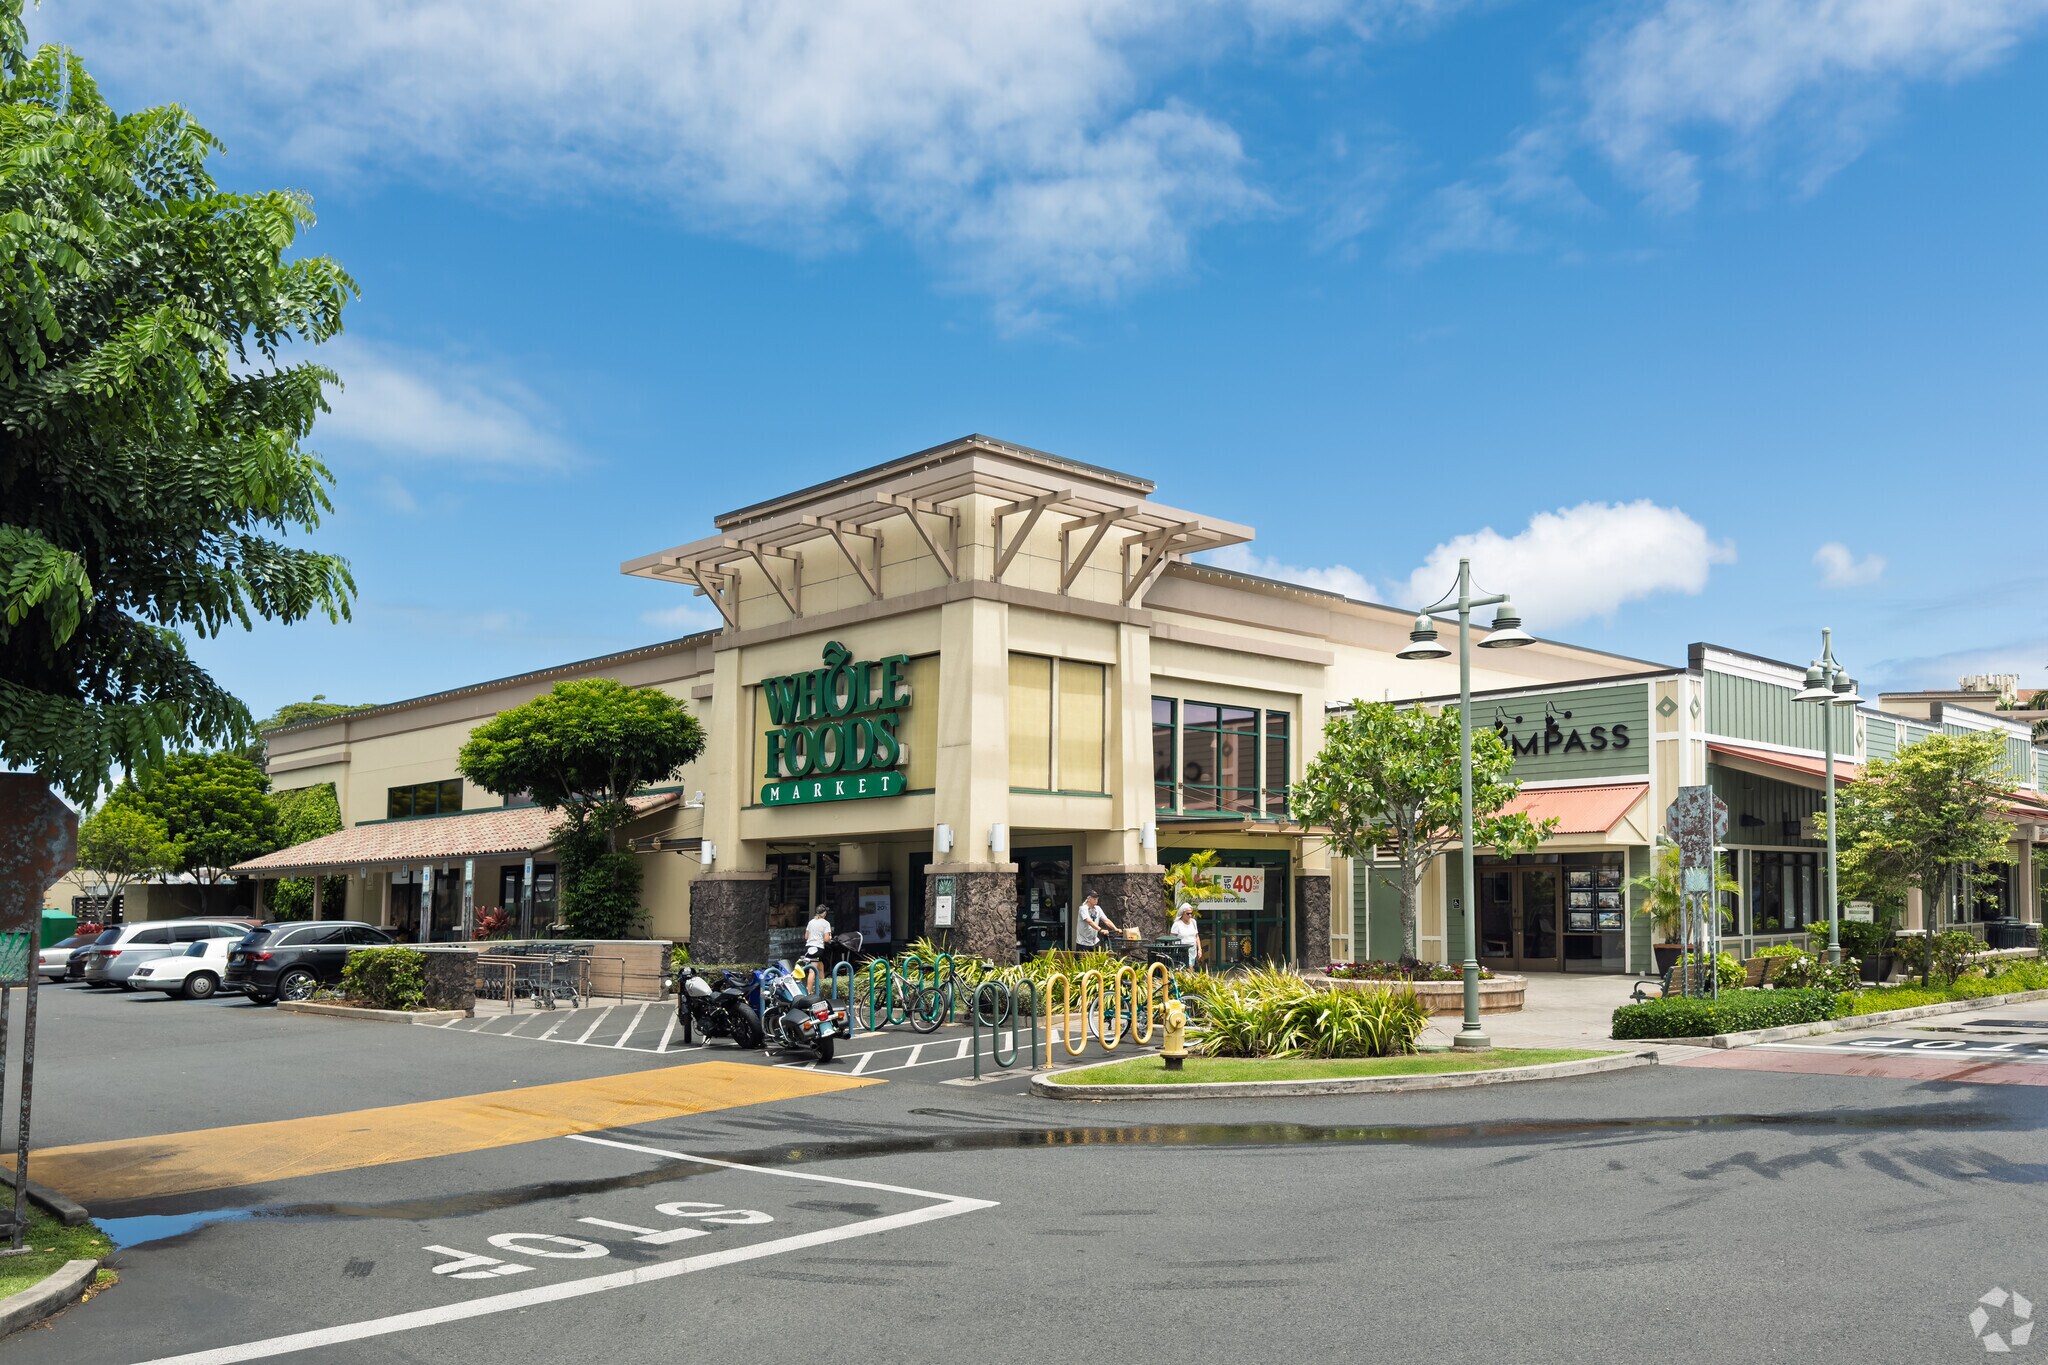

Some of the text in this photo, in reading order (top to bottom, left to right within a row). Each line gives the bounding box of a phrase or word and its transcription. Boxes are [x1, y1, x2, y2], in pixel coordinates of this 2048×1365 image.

[761, 653, 911, 725] WHOLE
[765, 713, 900, 778] FOODS
[1499, 724, 1630, 756] MPASS
[770, 776, 890, 801] MARKET
[1848, 1039, 2048, 1053] TOP
[421, 1201, 774, 1279] STOP
